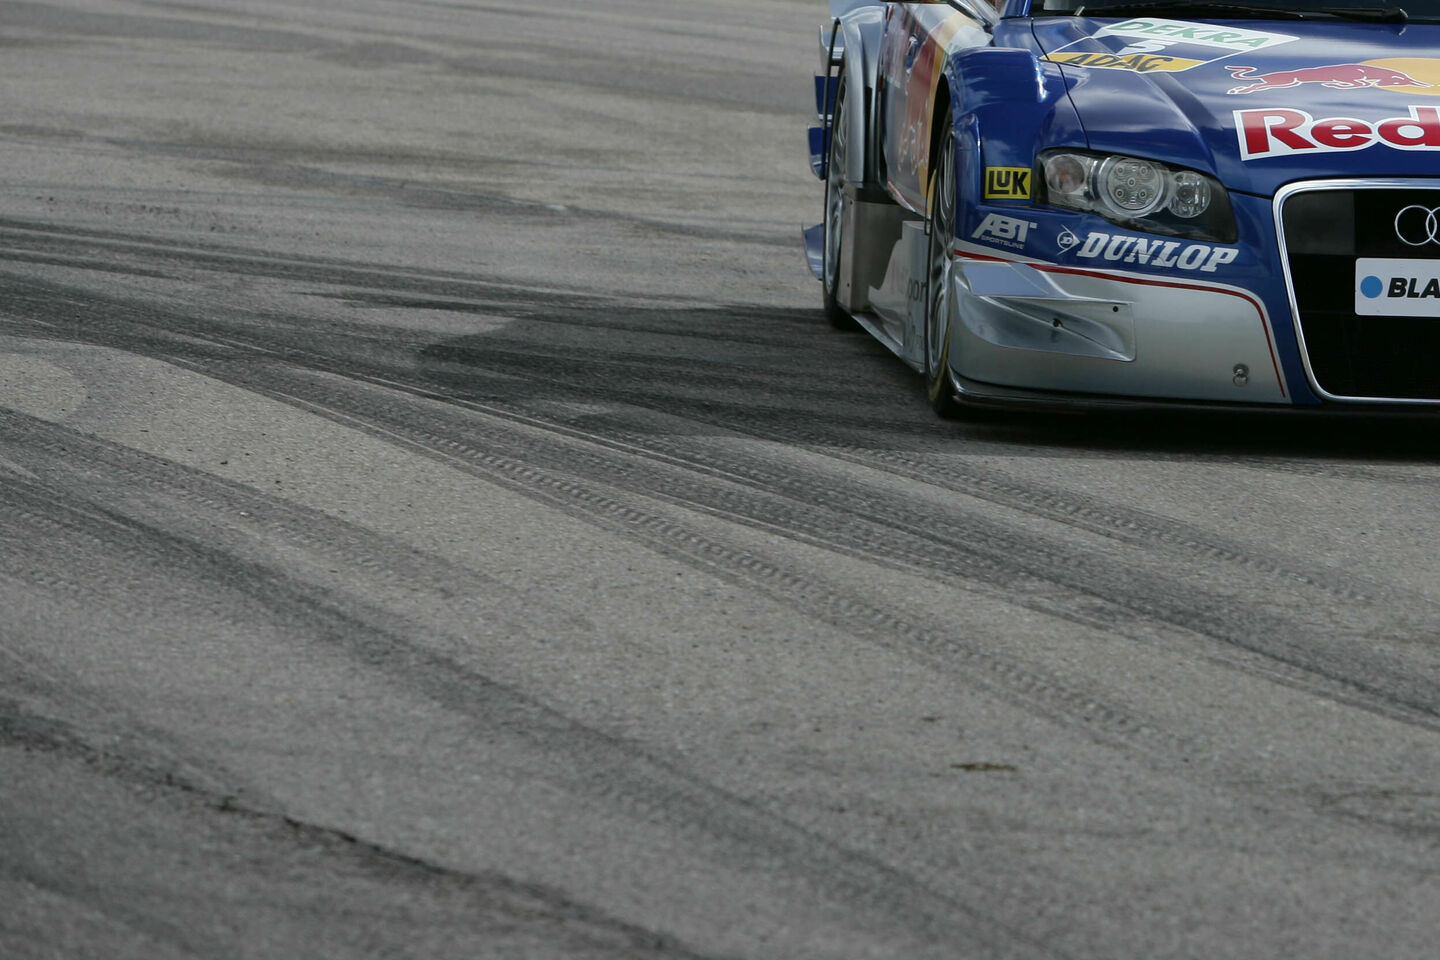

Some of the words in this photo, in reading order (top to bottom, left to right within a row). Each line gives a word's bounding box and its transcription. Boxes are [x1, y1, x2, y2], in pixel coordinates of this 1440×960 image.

[1107, 21, 1270, 48] DEKRA
[1064, 53, 1174, 72] ADAC
[971, 213, 1030, 241] ABT
[981, 236, 1025, 250] SPORTSLINE
[1076, 232, 1239, 273] DUNLOP
